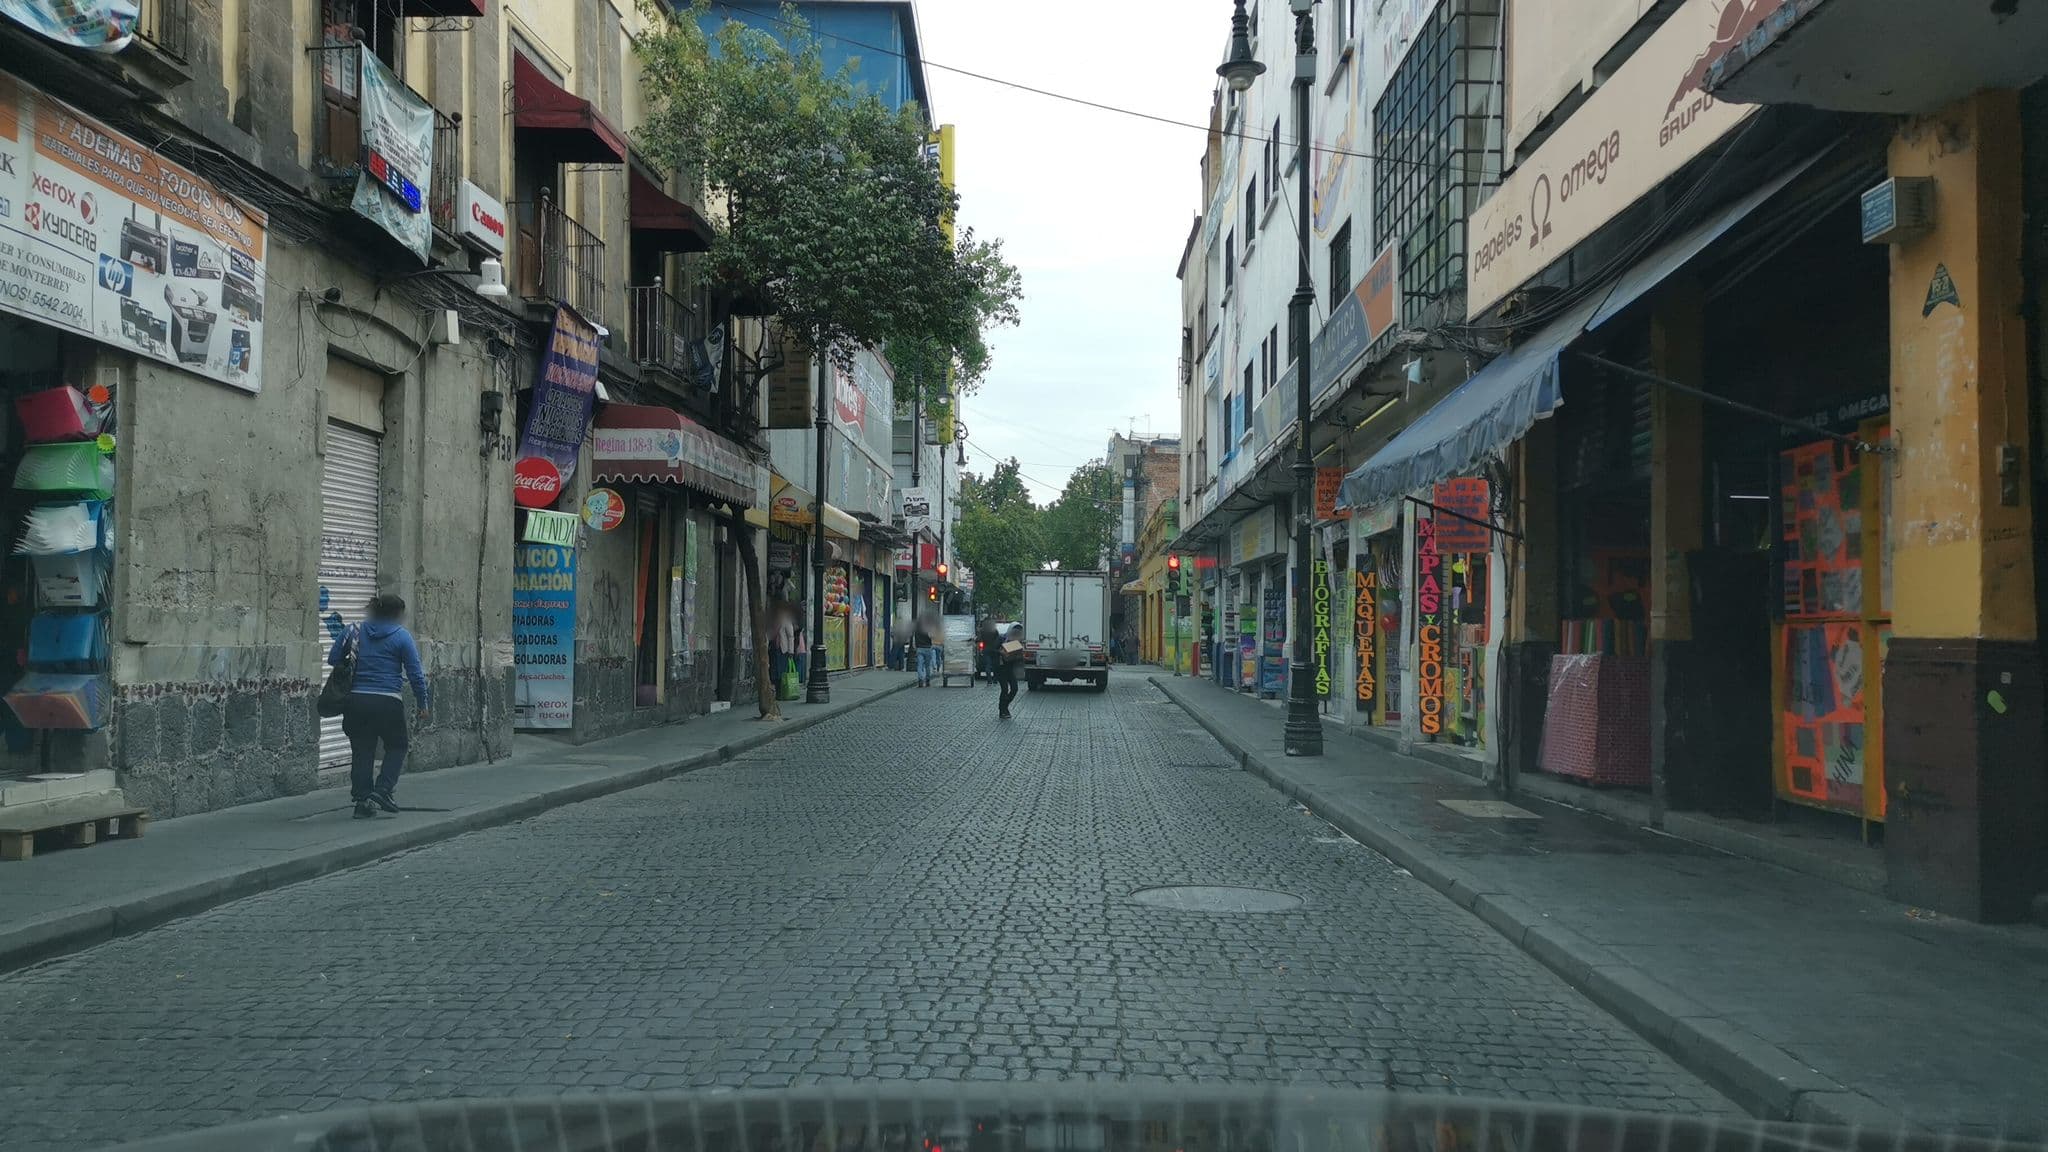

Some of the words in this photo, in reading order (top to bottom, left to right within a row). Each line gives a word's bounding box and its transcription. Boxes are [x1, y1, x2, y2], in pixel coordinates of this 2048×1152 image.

[1659, 93, 1714, 148] GRUPO
[41, 133, 101, 174] MATERIALES
[101, 165, 125, 187] PARA
[126, 179, 145, 197] QUE
[69, 121, 143, 175] ADEMAS
[215, 196, 244, 226] LOS
[32, 170, 77, 209] xerox
[1473, 213, 1523, 281] papeles
[1560, 129, 1620, 203] omega
[42, 209, 97, 253] KYOCERA
[472, 202, 504, 239] Canon
[11, 262, 72, 294] MONTERREY
[26, 251, 88, 284] CONSUMIBLES
[32, 291, 60, 312] 5542
[60, 301, 84, 319] 2004
[1838, 393, 1889, 421] OMEGA
[595, 438, 625, 454] Regina
[530, 511, 575, 546] TIENDA
[514, 548, 558, 568] VICIO
[561, 548, 573, 568] Y
[1418, 518, 1442, 614] MAPAS
[1314, 560, 1331, 695] BIOGRAFIAS
[1356, 572, 1376, 700] MAQUETAS
[514, 653, 567, 665] GOLADORAS
[1419, 625, 1443, 734] CROMOS
[537, 700, 568, 709] xerox
